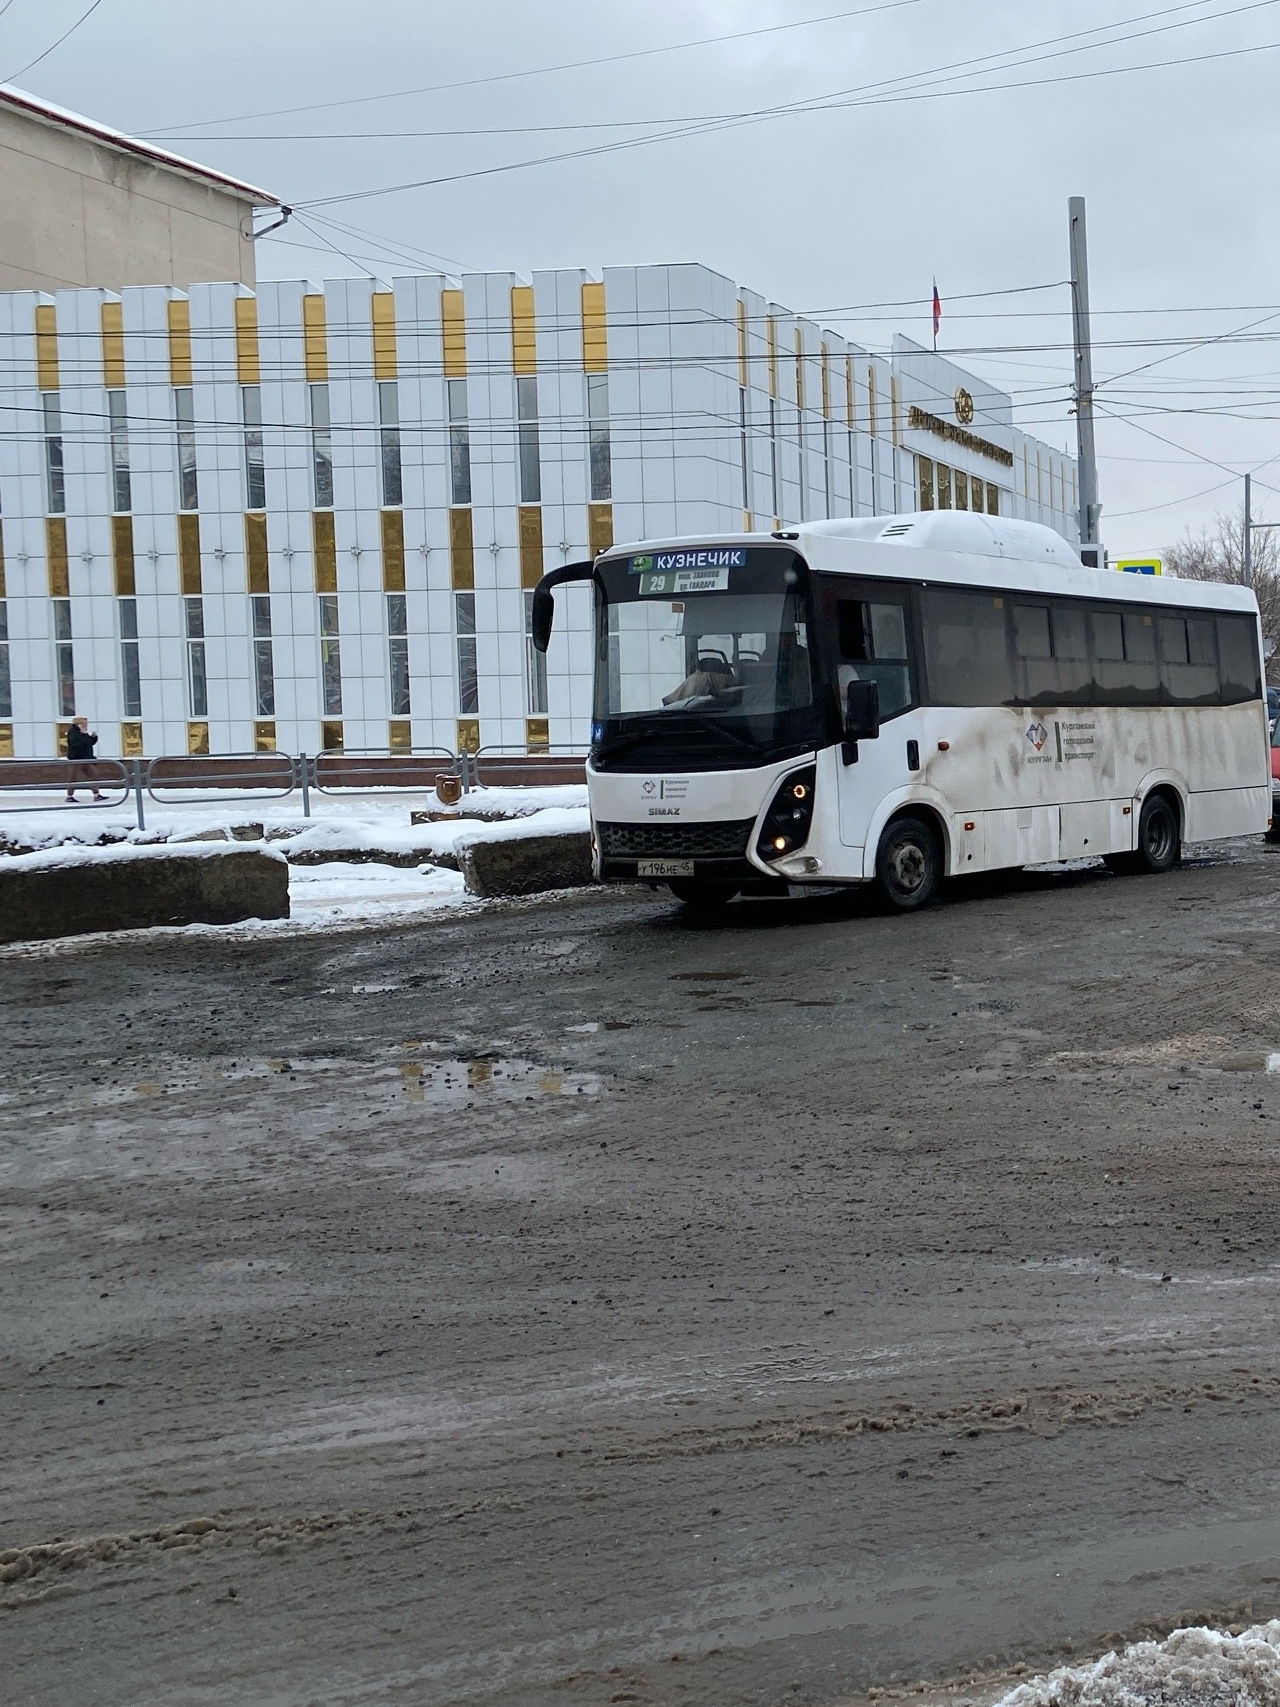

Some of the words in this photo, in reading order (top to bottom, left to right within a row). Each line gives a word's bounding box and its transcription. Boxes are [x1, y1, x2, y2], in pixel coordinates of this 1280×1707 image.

[657, 551, 741, 569] КУЗНЕЧИК
[650, 576, 666, 591] 29
[689, 580, 715, 589] ГАЙДАРА
[1061, 721, 1096, 732] Курганский
[1063, 736, 1094, 747] городской
[1027, 755, 1052, 764] КУРГАН
[1064, 752, 1096, 761] транспорт
[648, 807, 680, 816] SIMAZ
